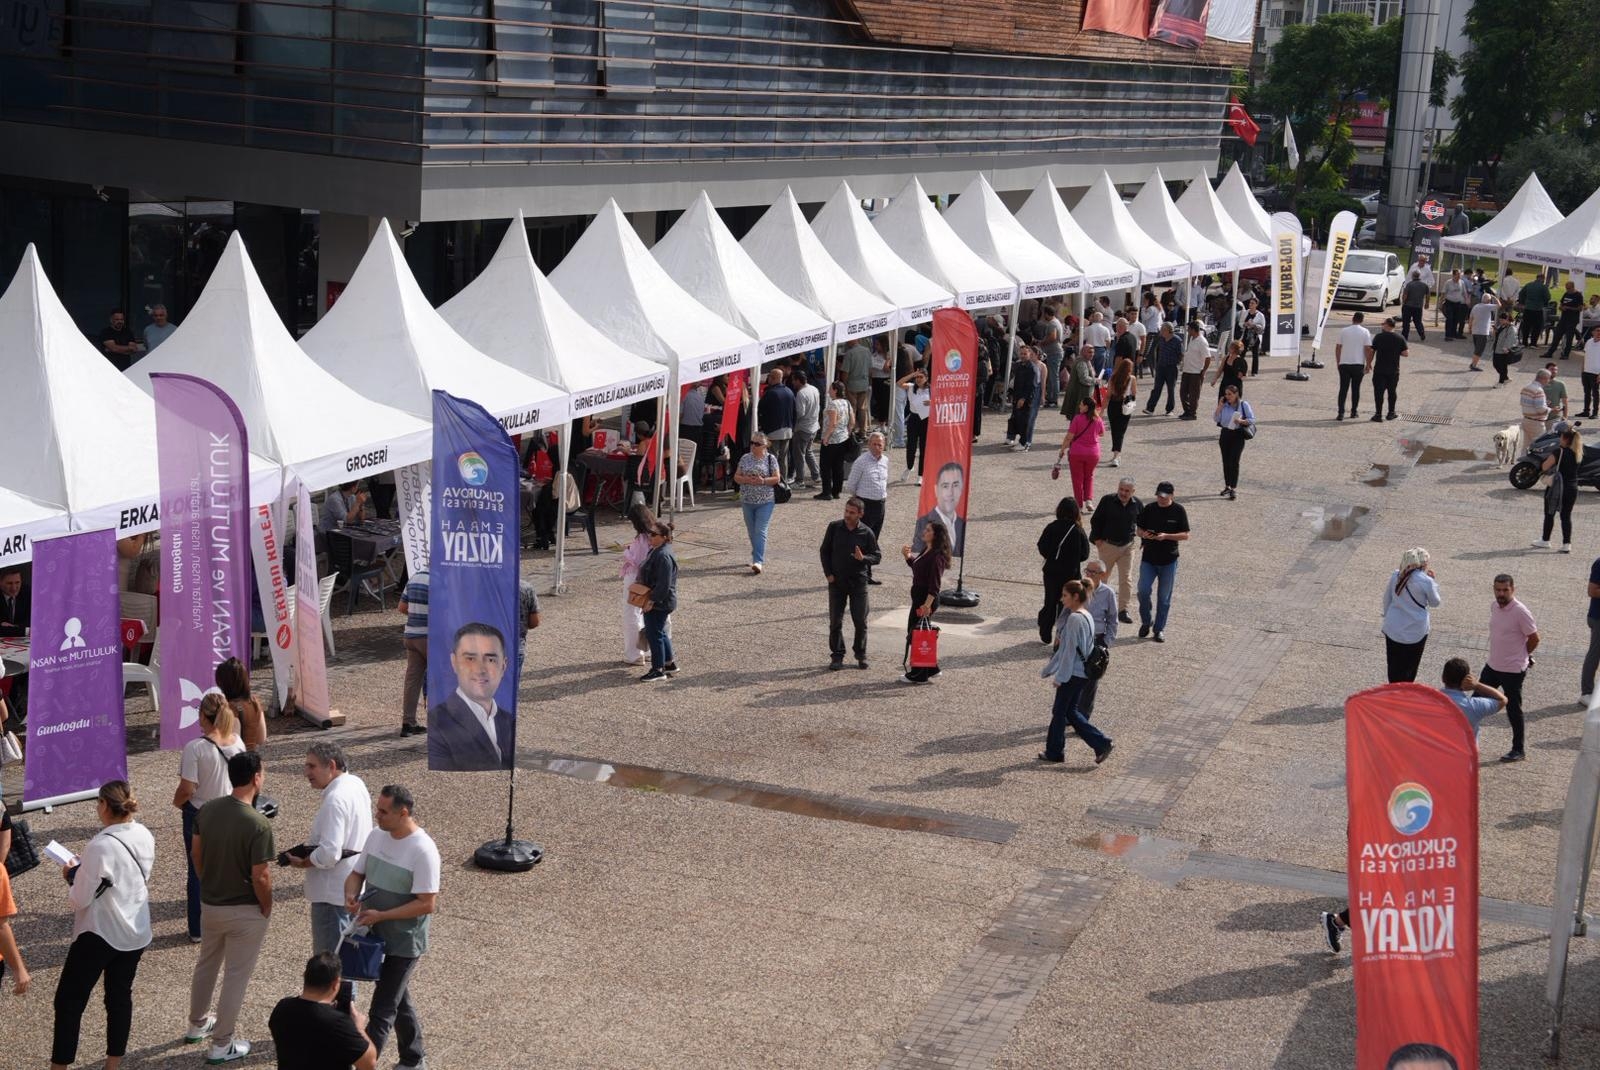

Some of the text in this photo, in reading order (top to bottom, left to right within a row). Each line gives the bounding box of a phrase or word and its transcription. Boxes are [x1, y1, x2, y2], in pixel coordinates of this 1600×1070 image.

[765, 344, 776, 356] ÖZEL
[699, 351, 742, 374] MEKTEBİM KOLEJİ
[574, 374, 666, 411] GİRNE KOLEJİ ADANA KAMPÜSÜ
[345, 445, 389, 474] GROSERİ
[0, 533, 27, 557] ARI
[269, 563, 289, 622] ERKAN
[69, 644, 119, 662] MUTLULUK
